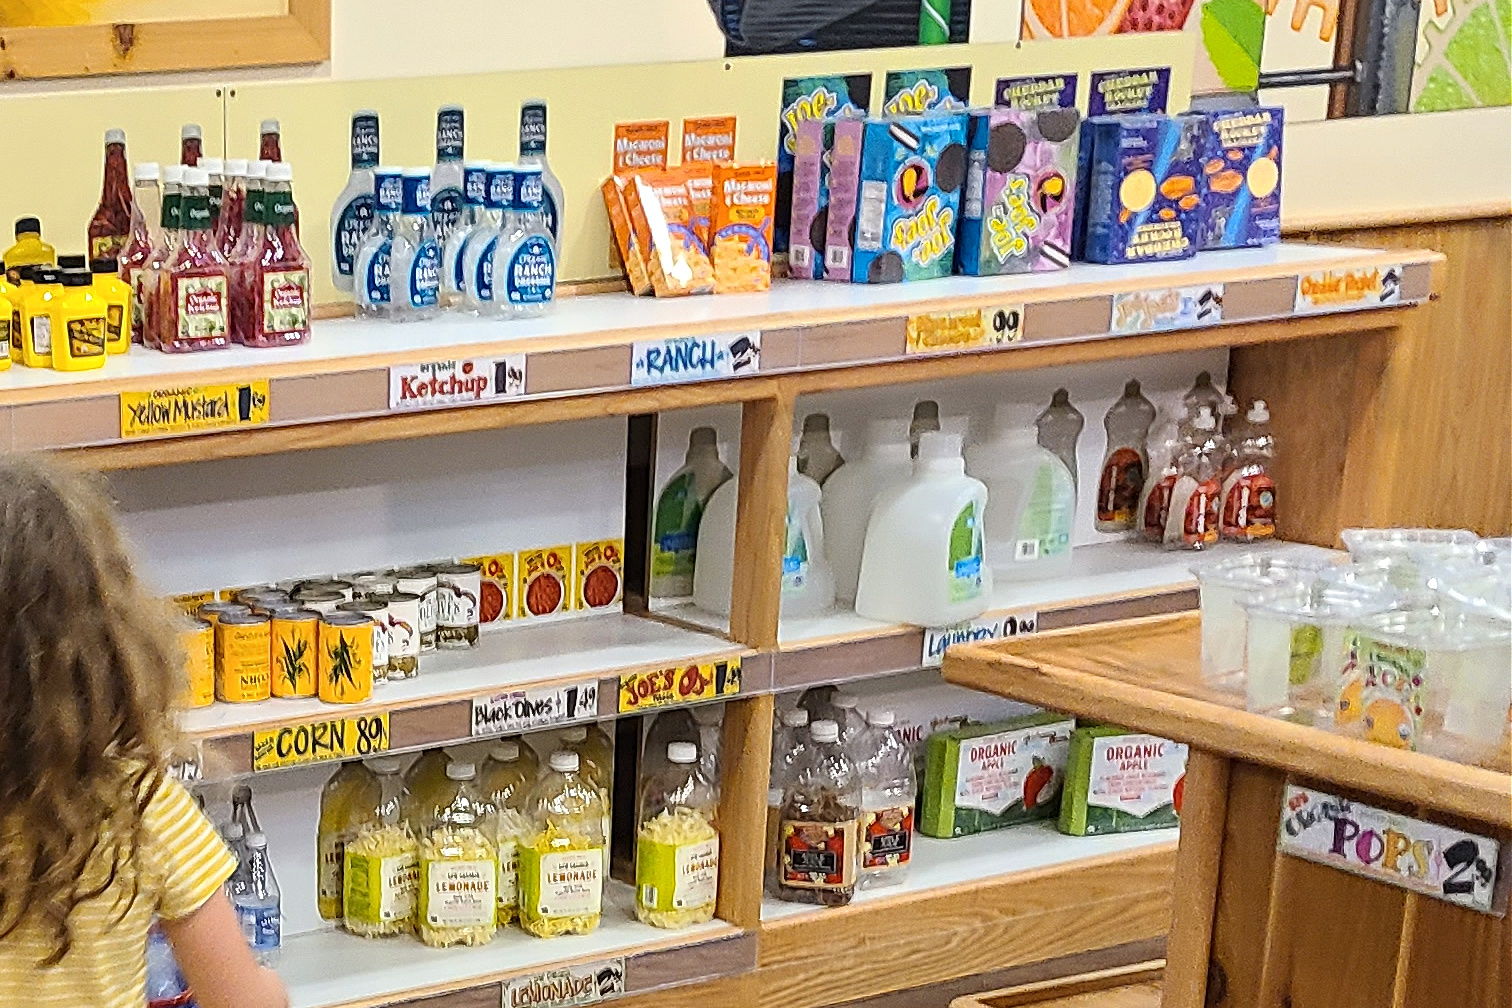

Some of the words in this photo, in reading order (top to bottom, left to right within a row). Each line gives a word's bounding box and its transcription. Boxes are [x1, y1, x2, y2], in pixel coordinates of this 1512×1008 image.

[514, 263, 552, 276] RANCH
[646, 339, 715, 375] RANCH
[399, 372, 488, 400] Ketchup
[127, 399, 171, 428] Yellow
[626, 666, 677, 706] JOE'S
[473, 700, 512, 726] Black
[276, 727, 346, 758] CORN
[970, 740, 1018, 763] ORGANIC
[1105, 742, 1165, 762] ORGANIC
[1329, 816, 1434, 878] POPS
[435, 880, 490, 893] LEMONADE
[546, 868, 597, 884] LEMONADE
[510, 973, 593, 1008] LEMONADE
